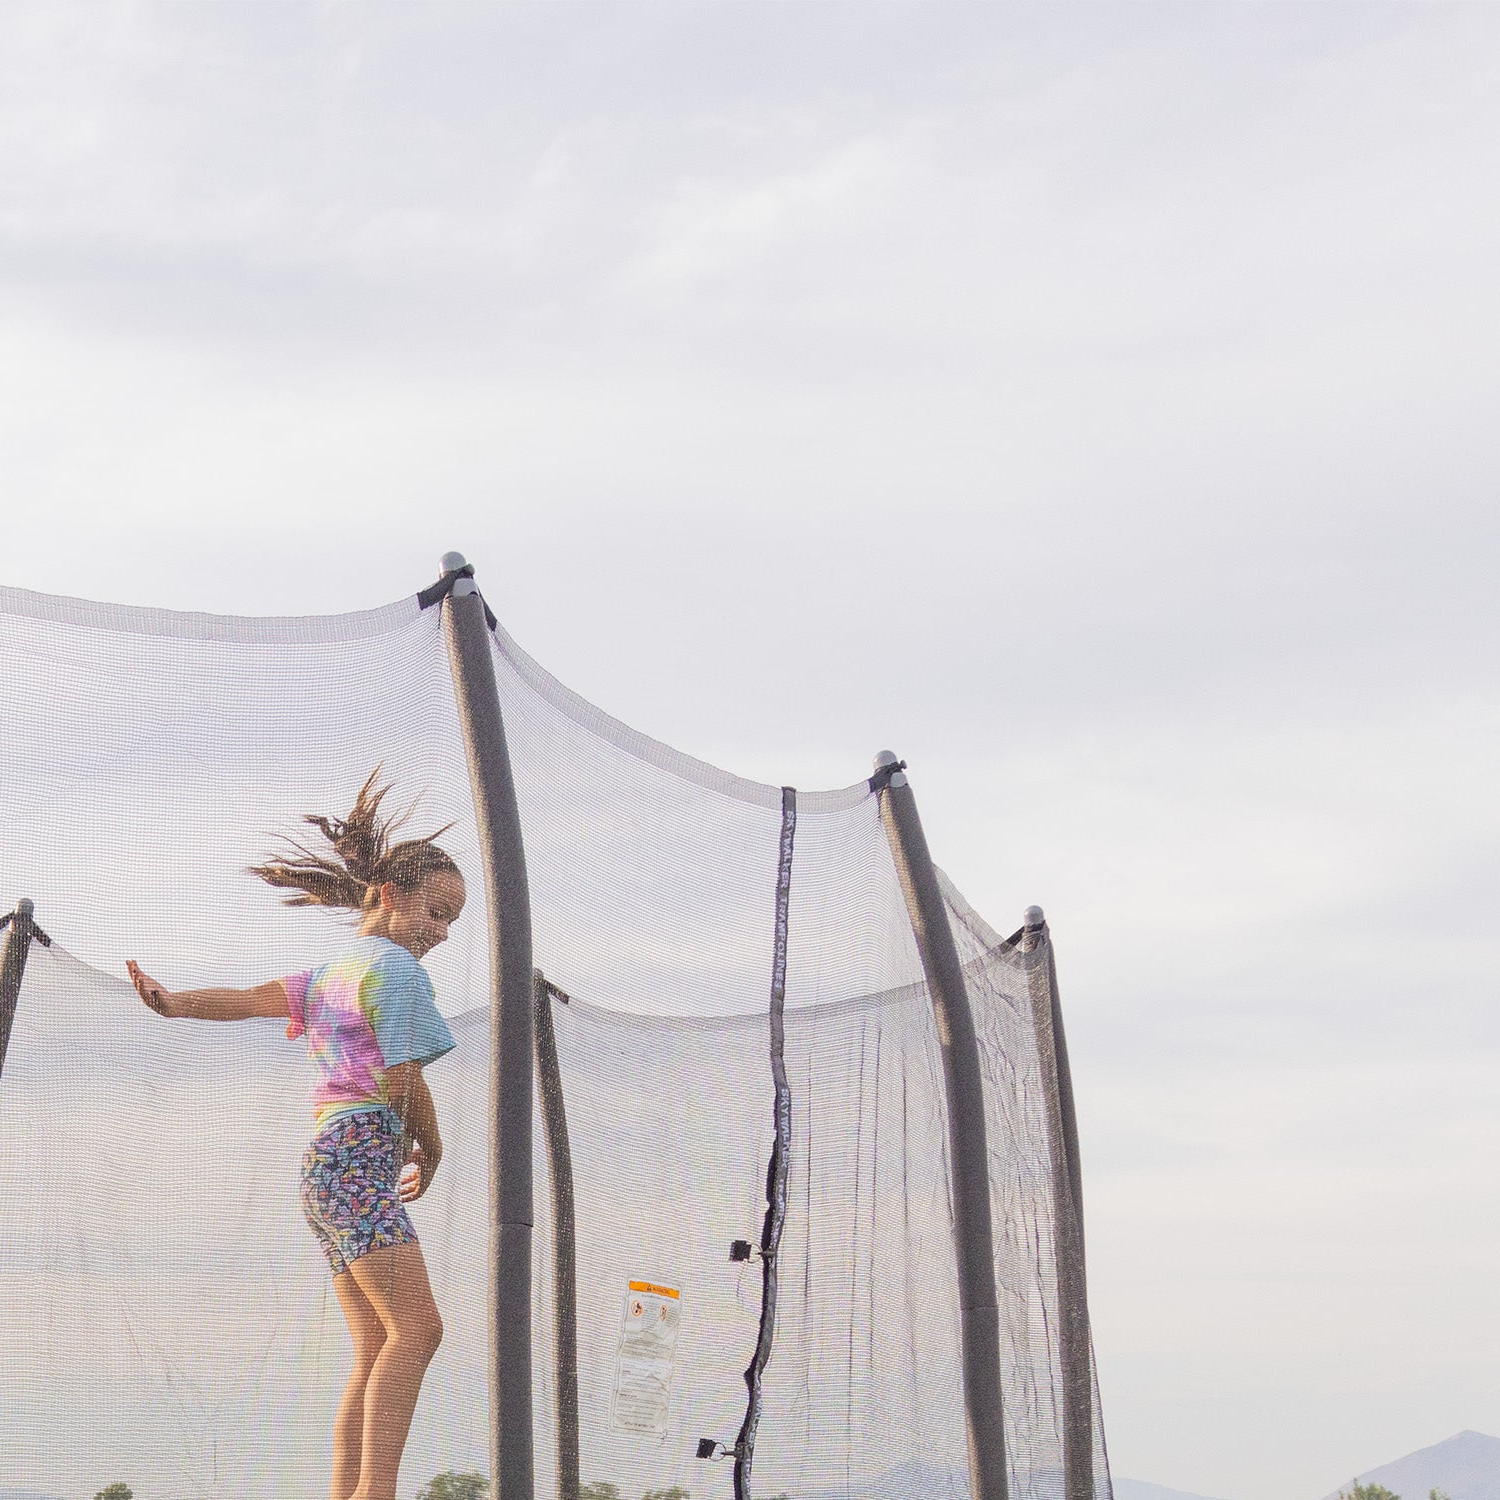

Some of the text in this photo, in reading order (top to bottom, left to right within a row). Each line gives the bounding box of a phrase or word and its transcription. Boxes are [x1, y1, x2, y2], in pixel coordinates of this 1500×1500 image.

[773, 810, 795, 988] SKYWALKER TRAMPOLINES
[780, 1088, 791, 1168] SKYWALKER
